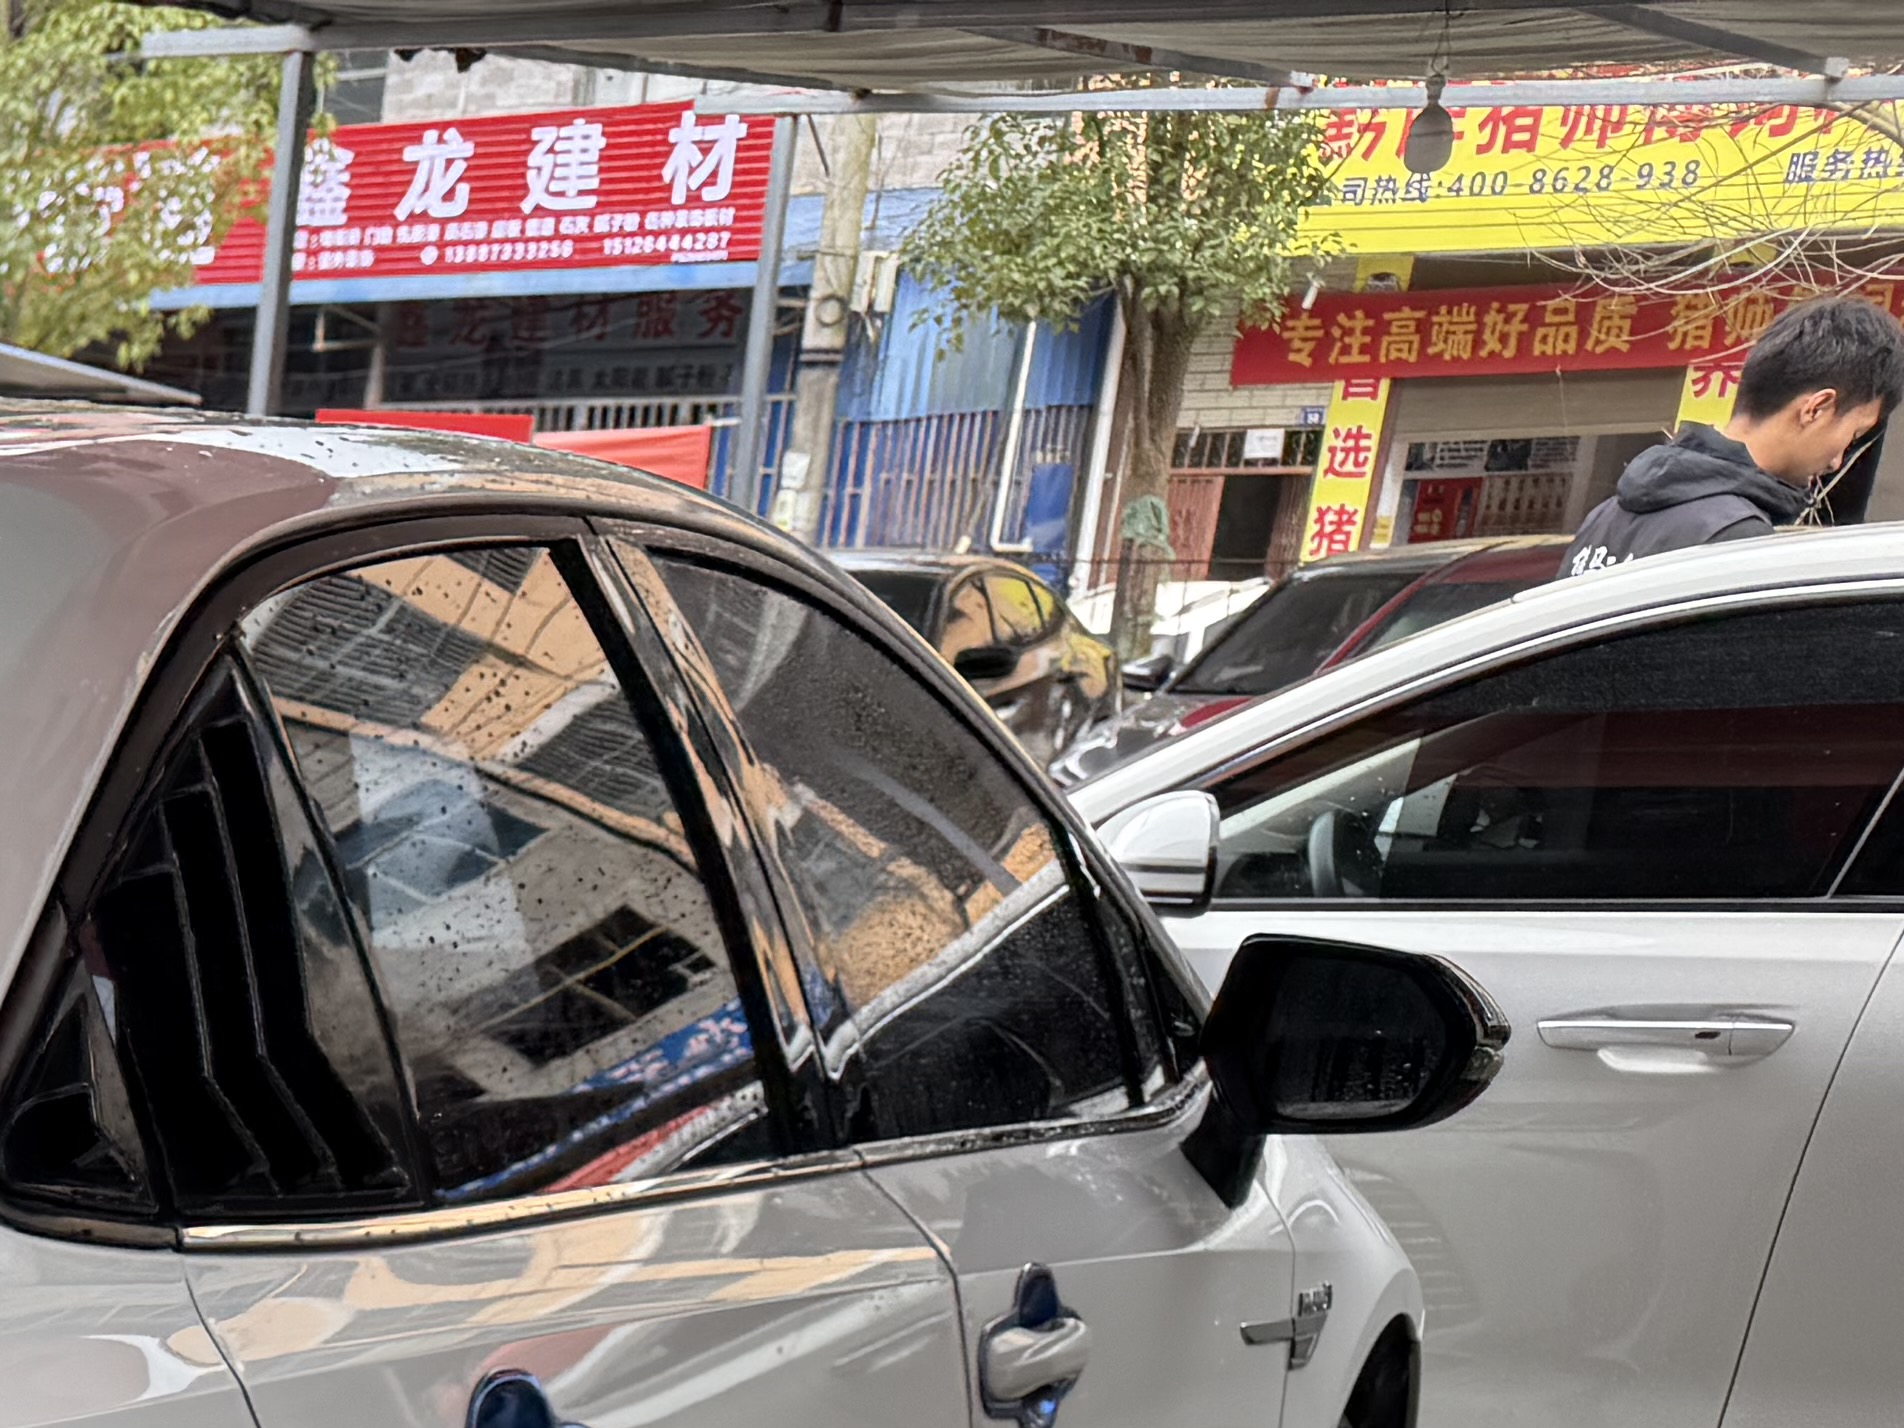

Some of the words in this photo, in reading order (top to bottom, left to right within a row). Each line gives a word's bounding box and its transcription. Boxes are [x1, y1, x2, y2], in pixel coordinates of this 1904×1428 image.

[296, 111, 747, 226] 鑫龙建材
[1784, 146, 1904, 184] 服务热
[1281, 295, 1637, 368] 专注高端好品质
